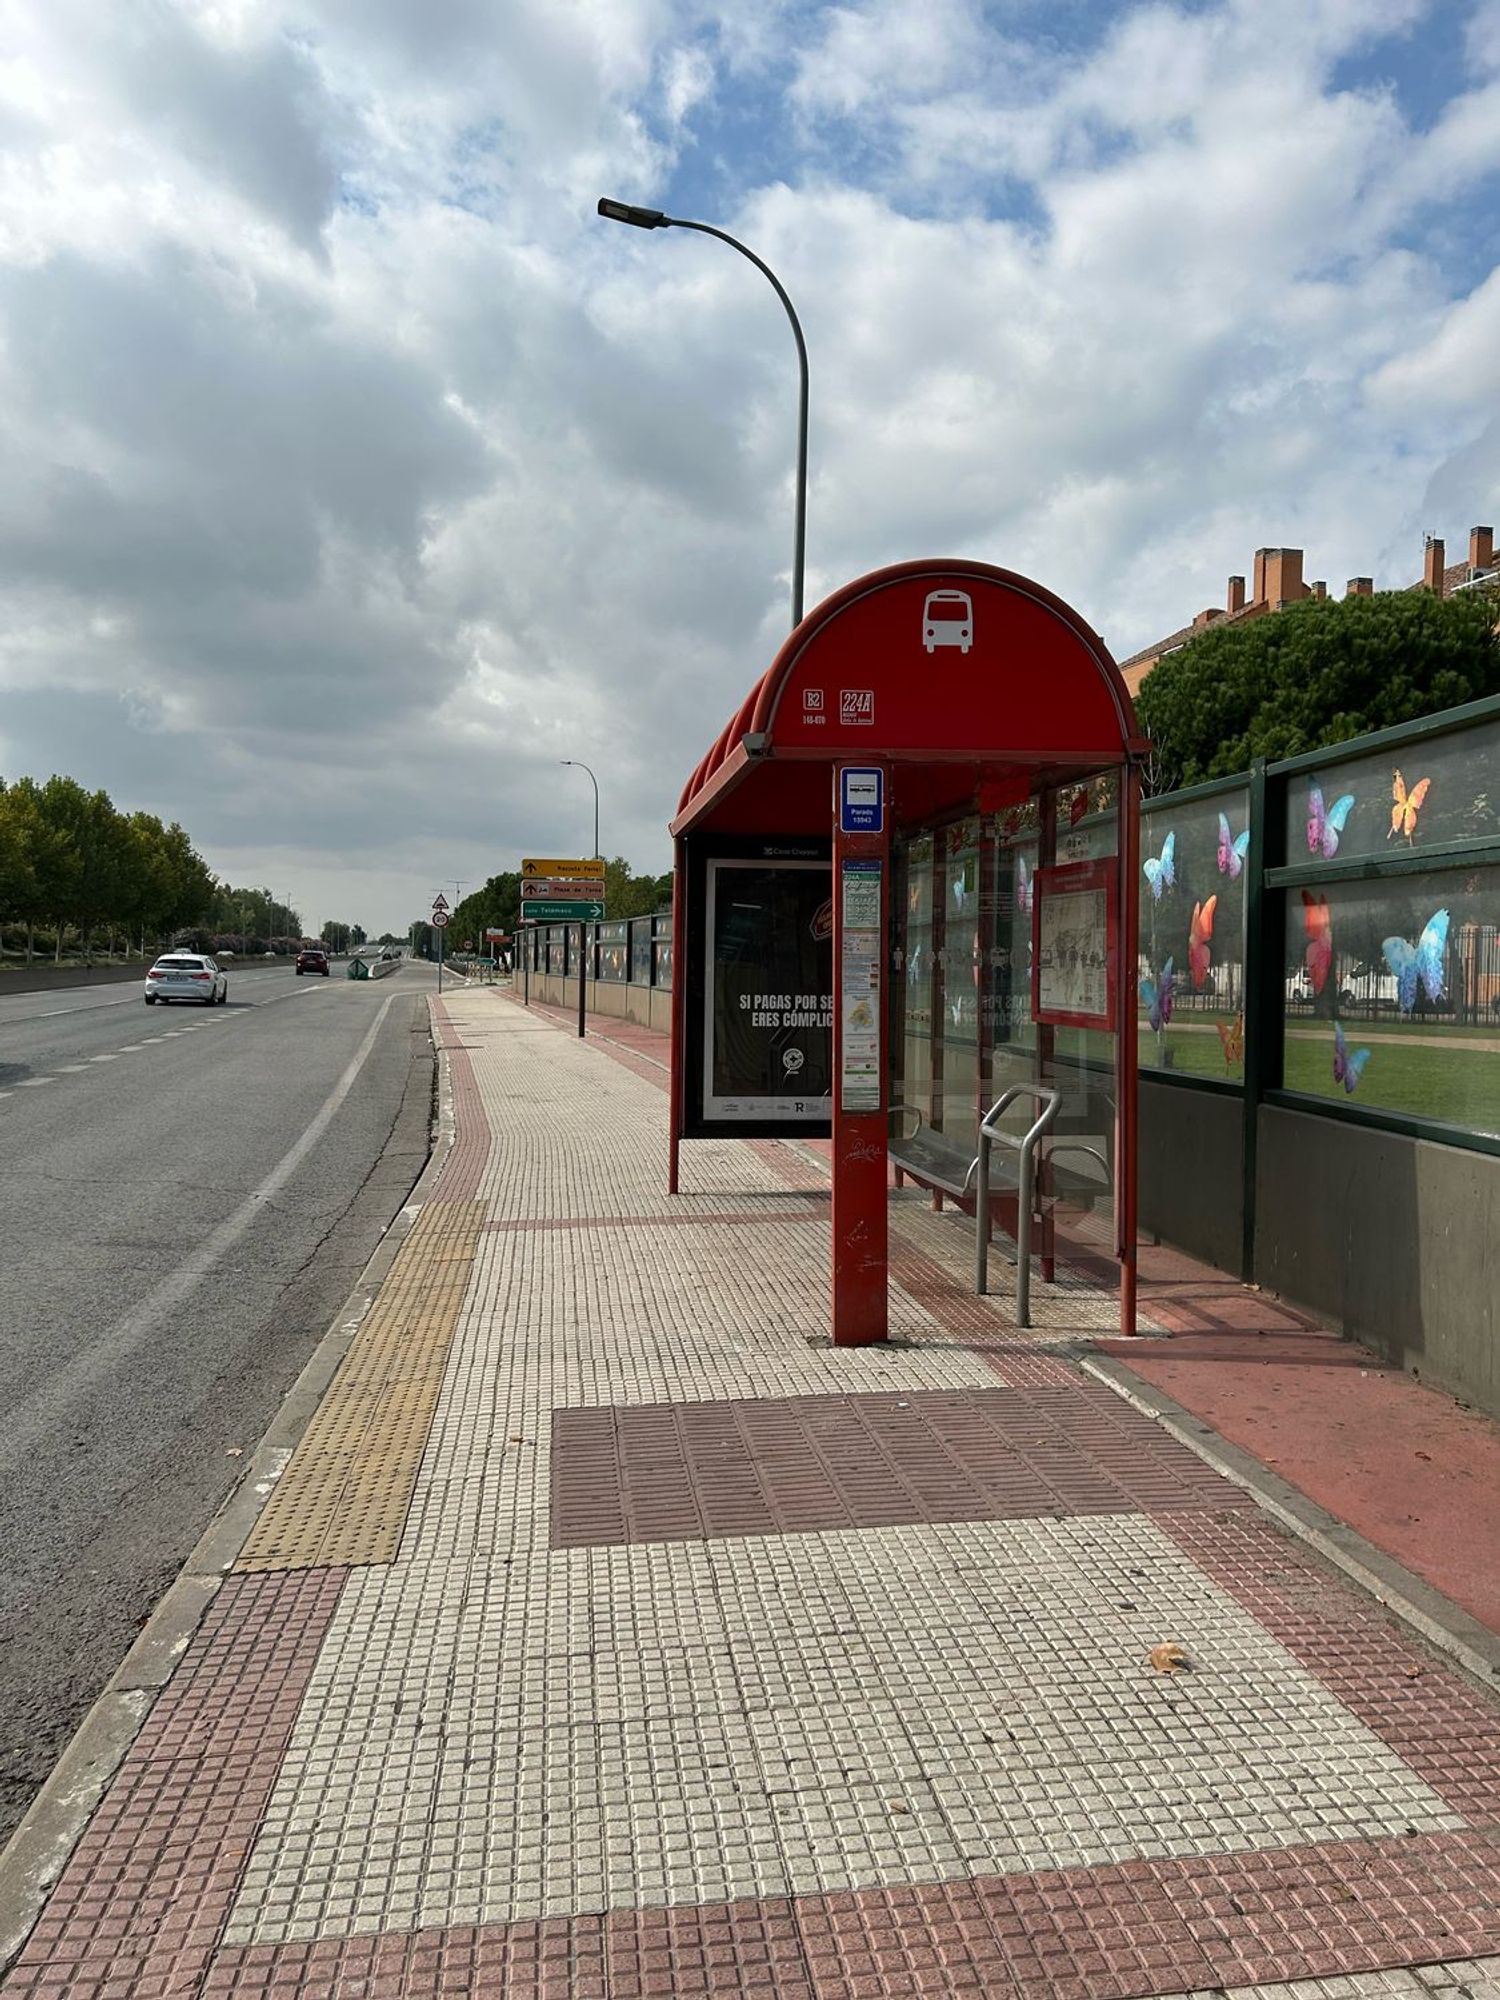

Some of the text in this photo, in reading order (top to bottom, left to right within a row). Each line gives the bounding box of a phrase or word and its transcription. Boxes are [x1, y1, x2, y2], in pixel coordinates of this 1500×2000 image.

[807, 692, 820, 706] B2
[843, 693, 872, 711] 224A
[739, 994, 751, 1010] SI
[754, 994, 791, 1010] PAGAS
[795, 994, 817, 1010] POR
[820, 994, 833, 1010] SE
[752, 1009, 833, 1027] ERES CÓMPLIC
